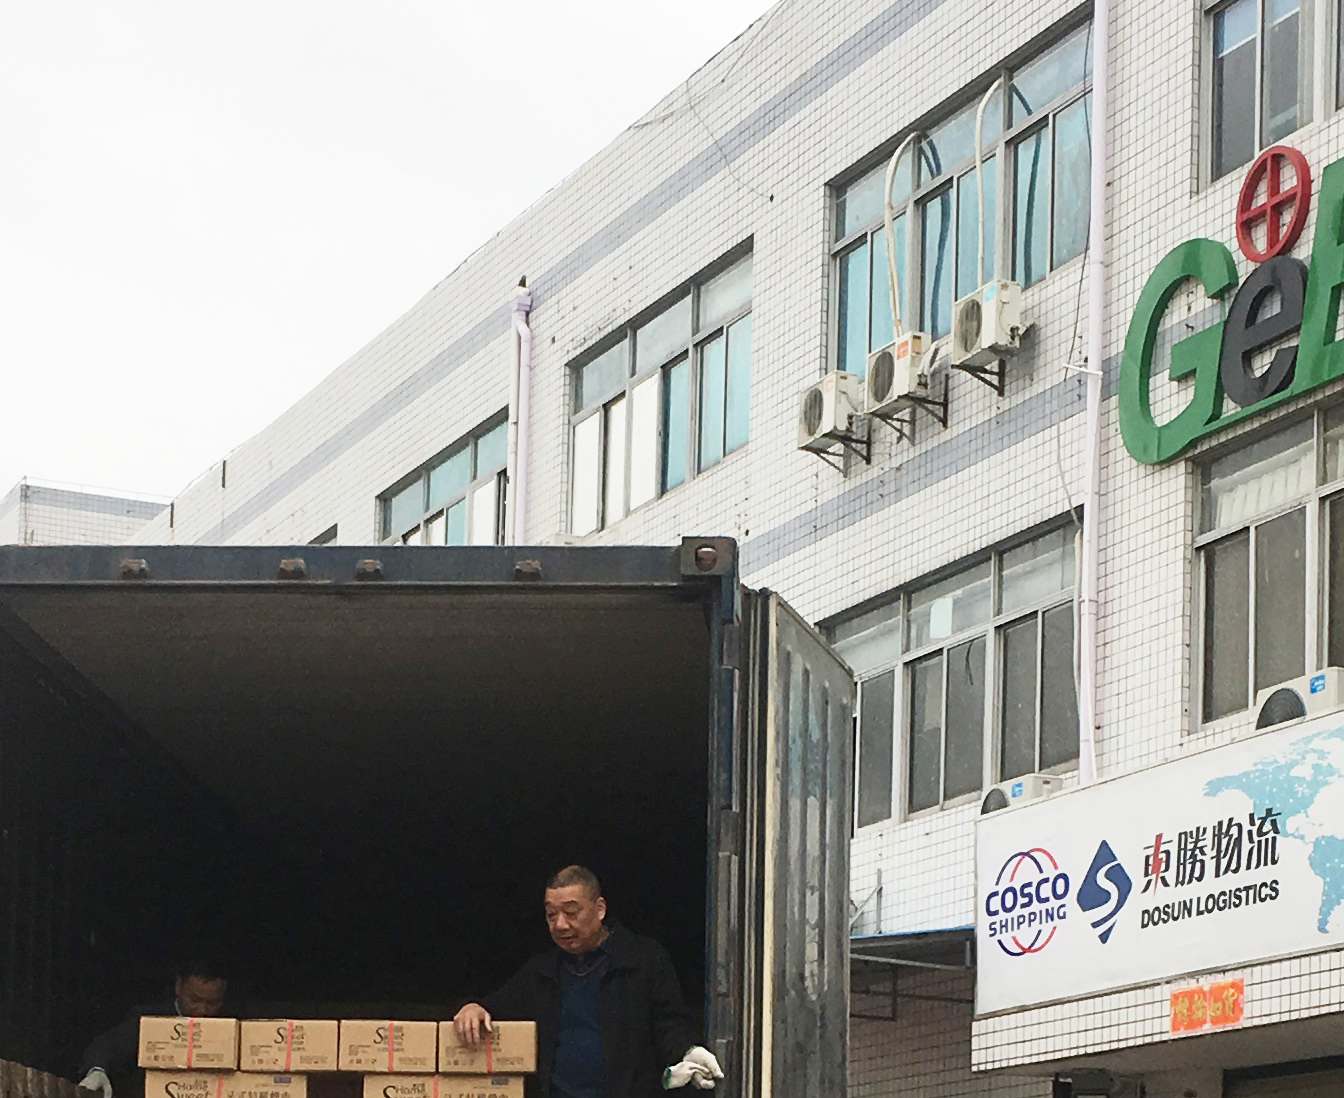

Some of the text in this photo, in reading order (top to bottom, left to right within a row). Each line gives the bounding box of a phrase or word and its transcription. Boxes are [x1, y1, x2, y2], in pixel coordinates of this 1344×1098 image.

[985, 872, 1071, 917] COSCO
[1140, 879, 1280, 929] DOSUN LOGISTICS
[988, 903, 1067, 938] SHIPPING
